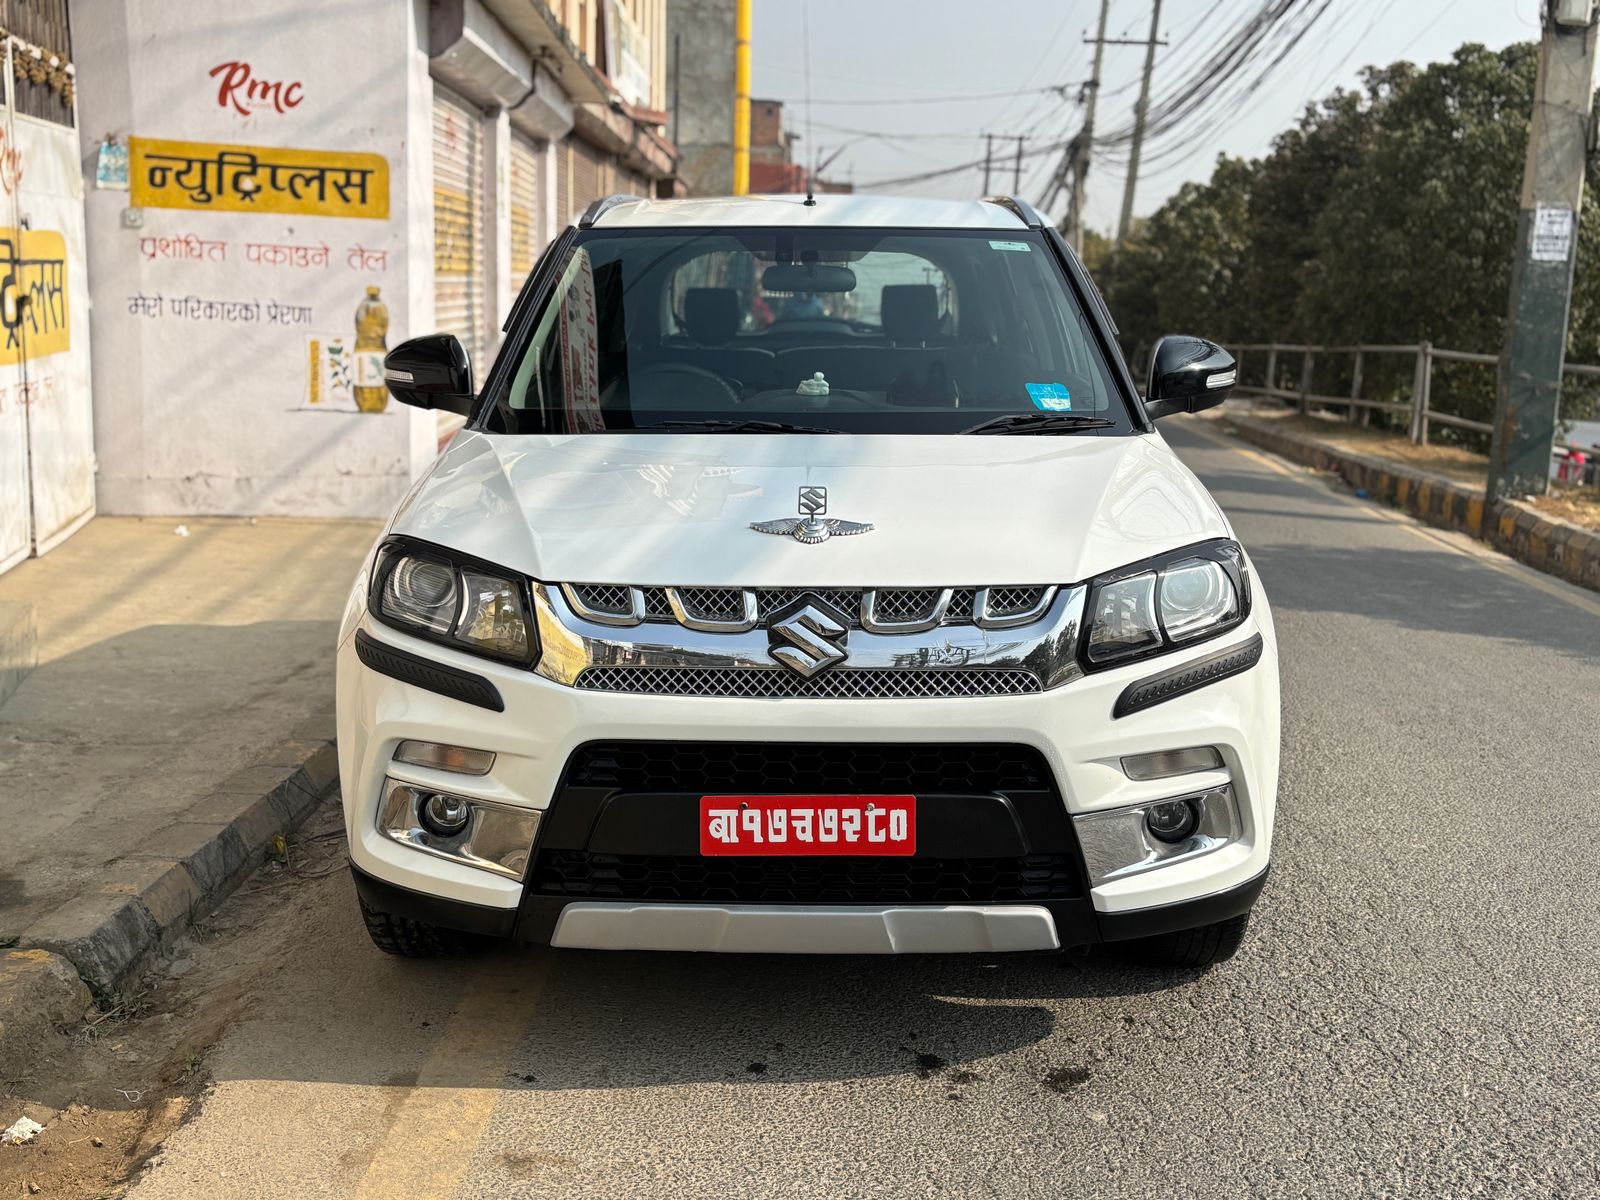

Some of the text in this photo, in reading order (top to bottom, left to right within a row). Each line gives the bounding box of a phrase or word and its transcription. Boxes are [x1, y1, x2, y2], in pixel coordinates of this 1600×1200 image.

[209, 61, 304, 116] Rmc
[144, 152, 374, 204] न्युट्रिप्लस
[140, 235, 388, 270] प्रशोधित पकाउने तेल
[127, 292, 313, 325] मेरो परिकारको प्रेरणा
